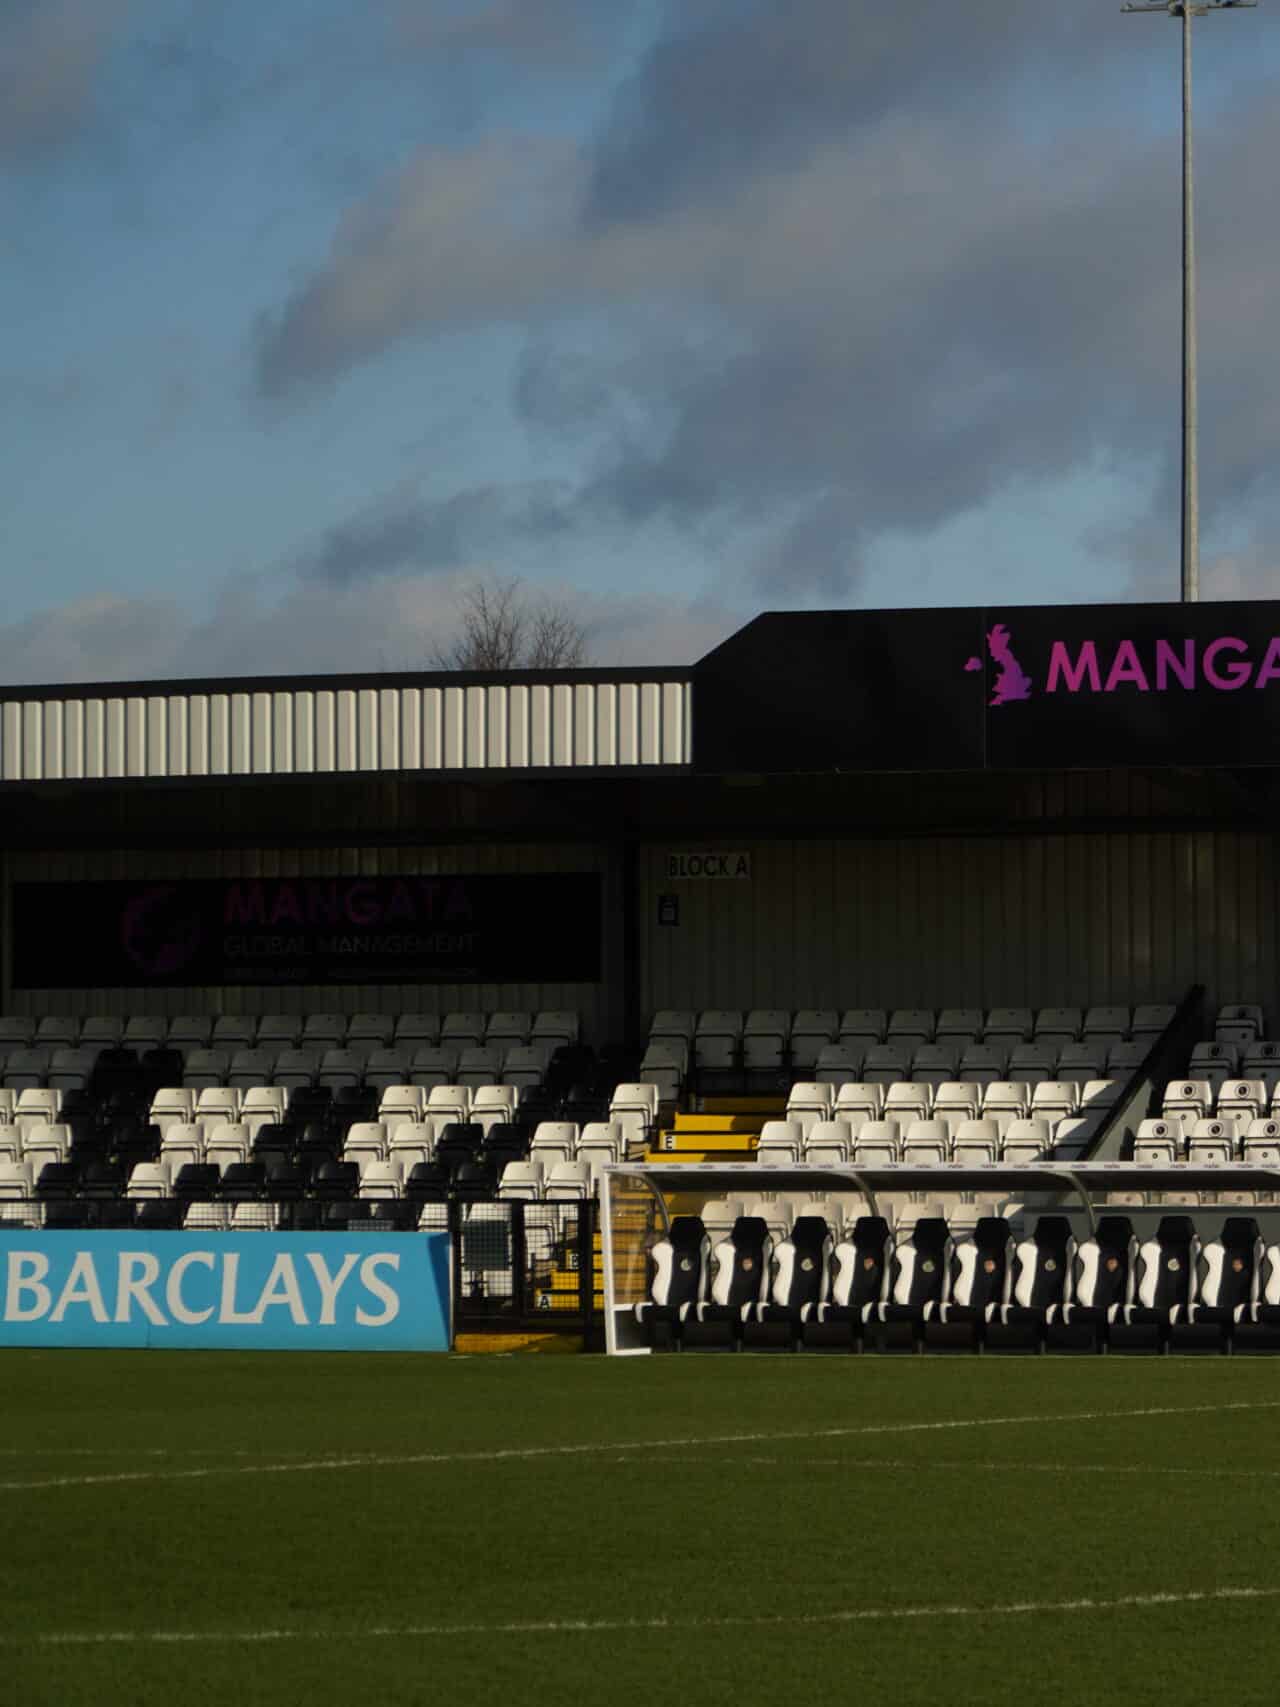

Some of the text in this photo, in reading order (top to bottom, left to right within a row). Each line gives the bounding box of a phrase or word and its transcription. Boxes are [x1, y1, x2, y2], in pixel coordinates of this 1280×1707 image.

[670, 855, 749, 876] BLOCK A
[223, 880, 474, 928] MANGATA
[4, 1251, 401, 1327] BARCLAYS
